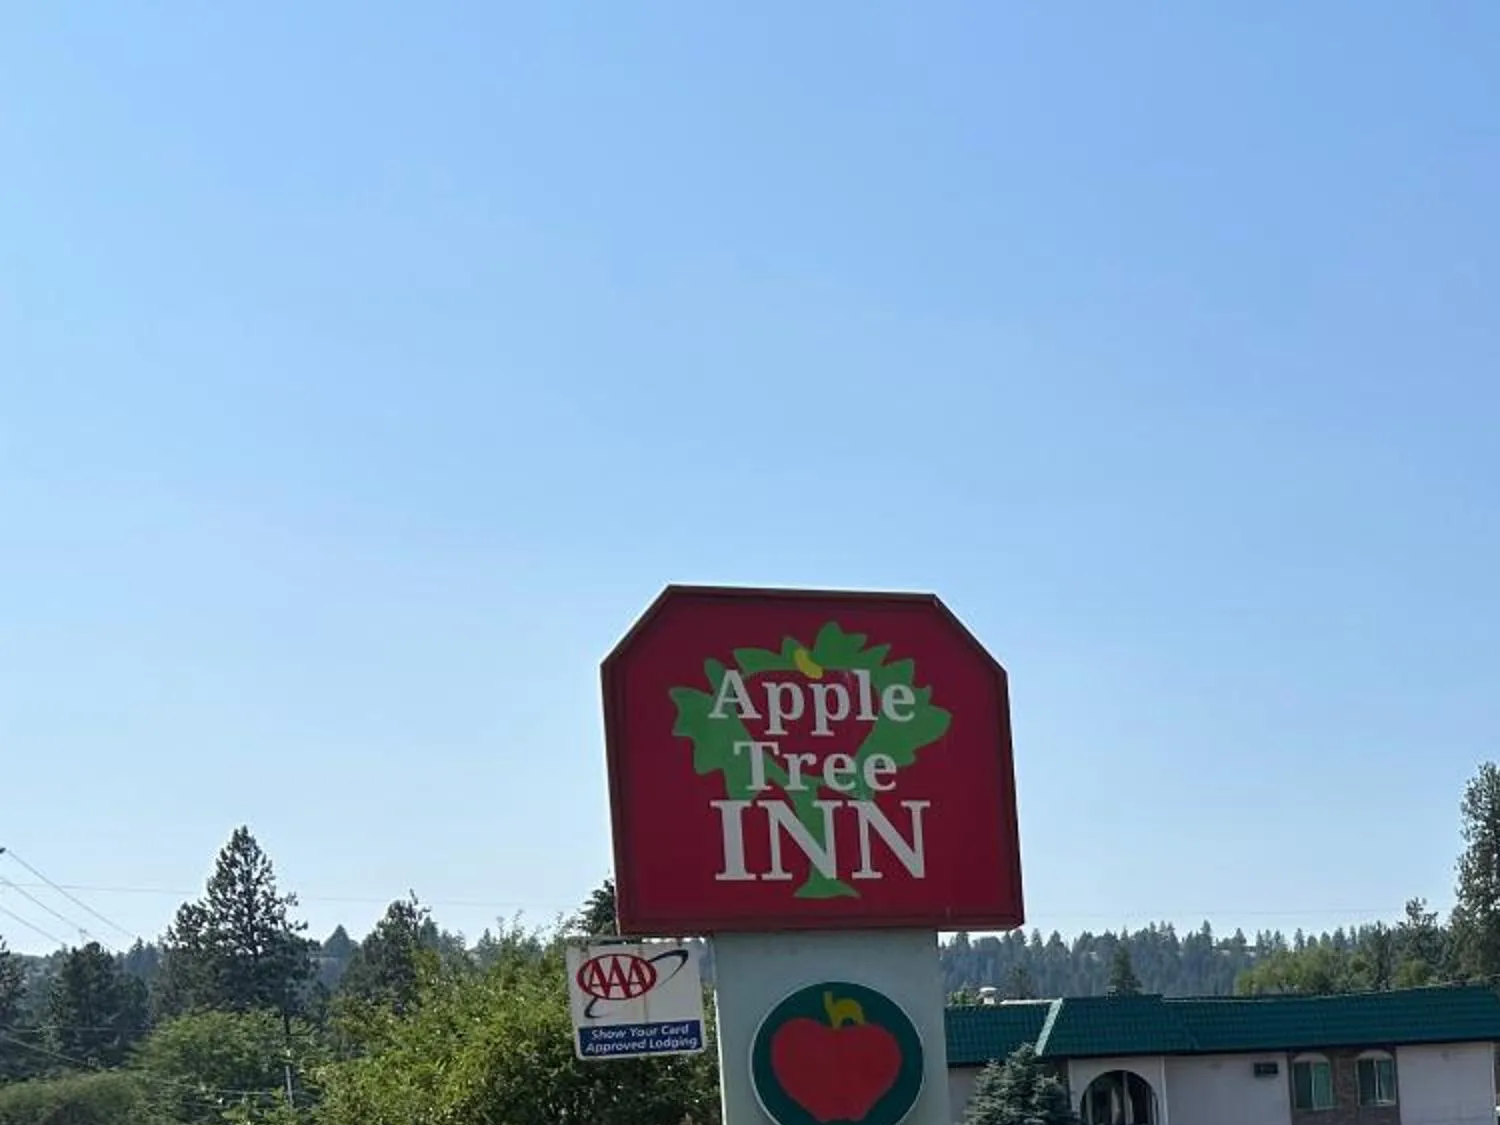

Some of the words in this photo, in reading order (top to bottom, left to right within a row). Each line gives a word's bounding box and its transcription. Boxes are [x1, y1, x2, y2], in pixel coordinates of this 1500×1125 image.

[708, 669, 916, 736] Apple
[733, 741, 898, 791] Tree
[709, 799, 931, 881] INN
[587, 955, 649, 998] AAA
[585, 1039, 647, 1054] Approved
[649, 1036, 697, 1050] Lodging
[591, 1028, 627, 1039] Show
[629, 1026, 658, 1038] Your
[661, 1024, 689, 1035] Card
